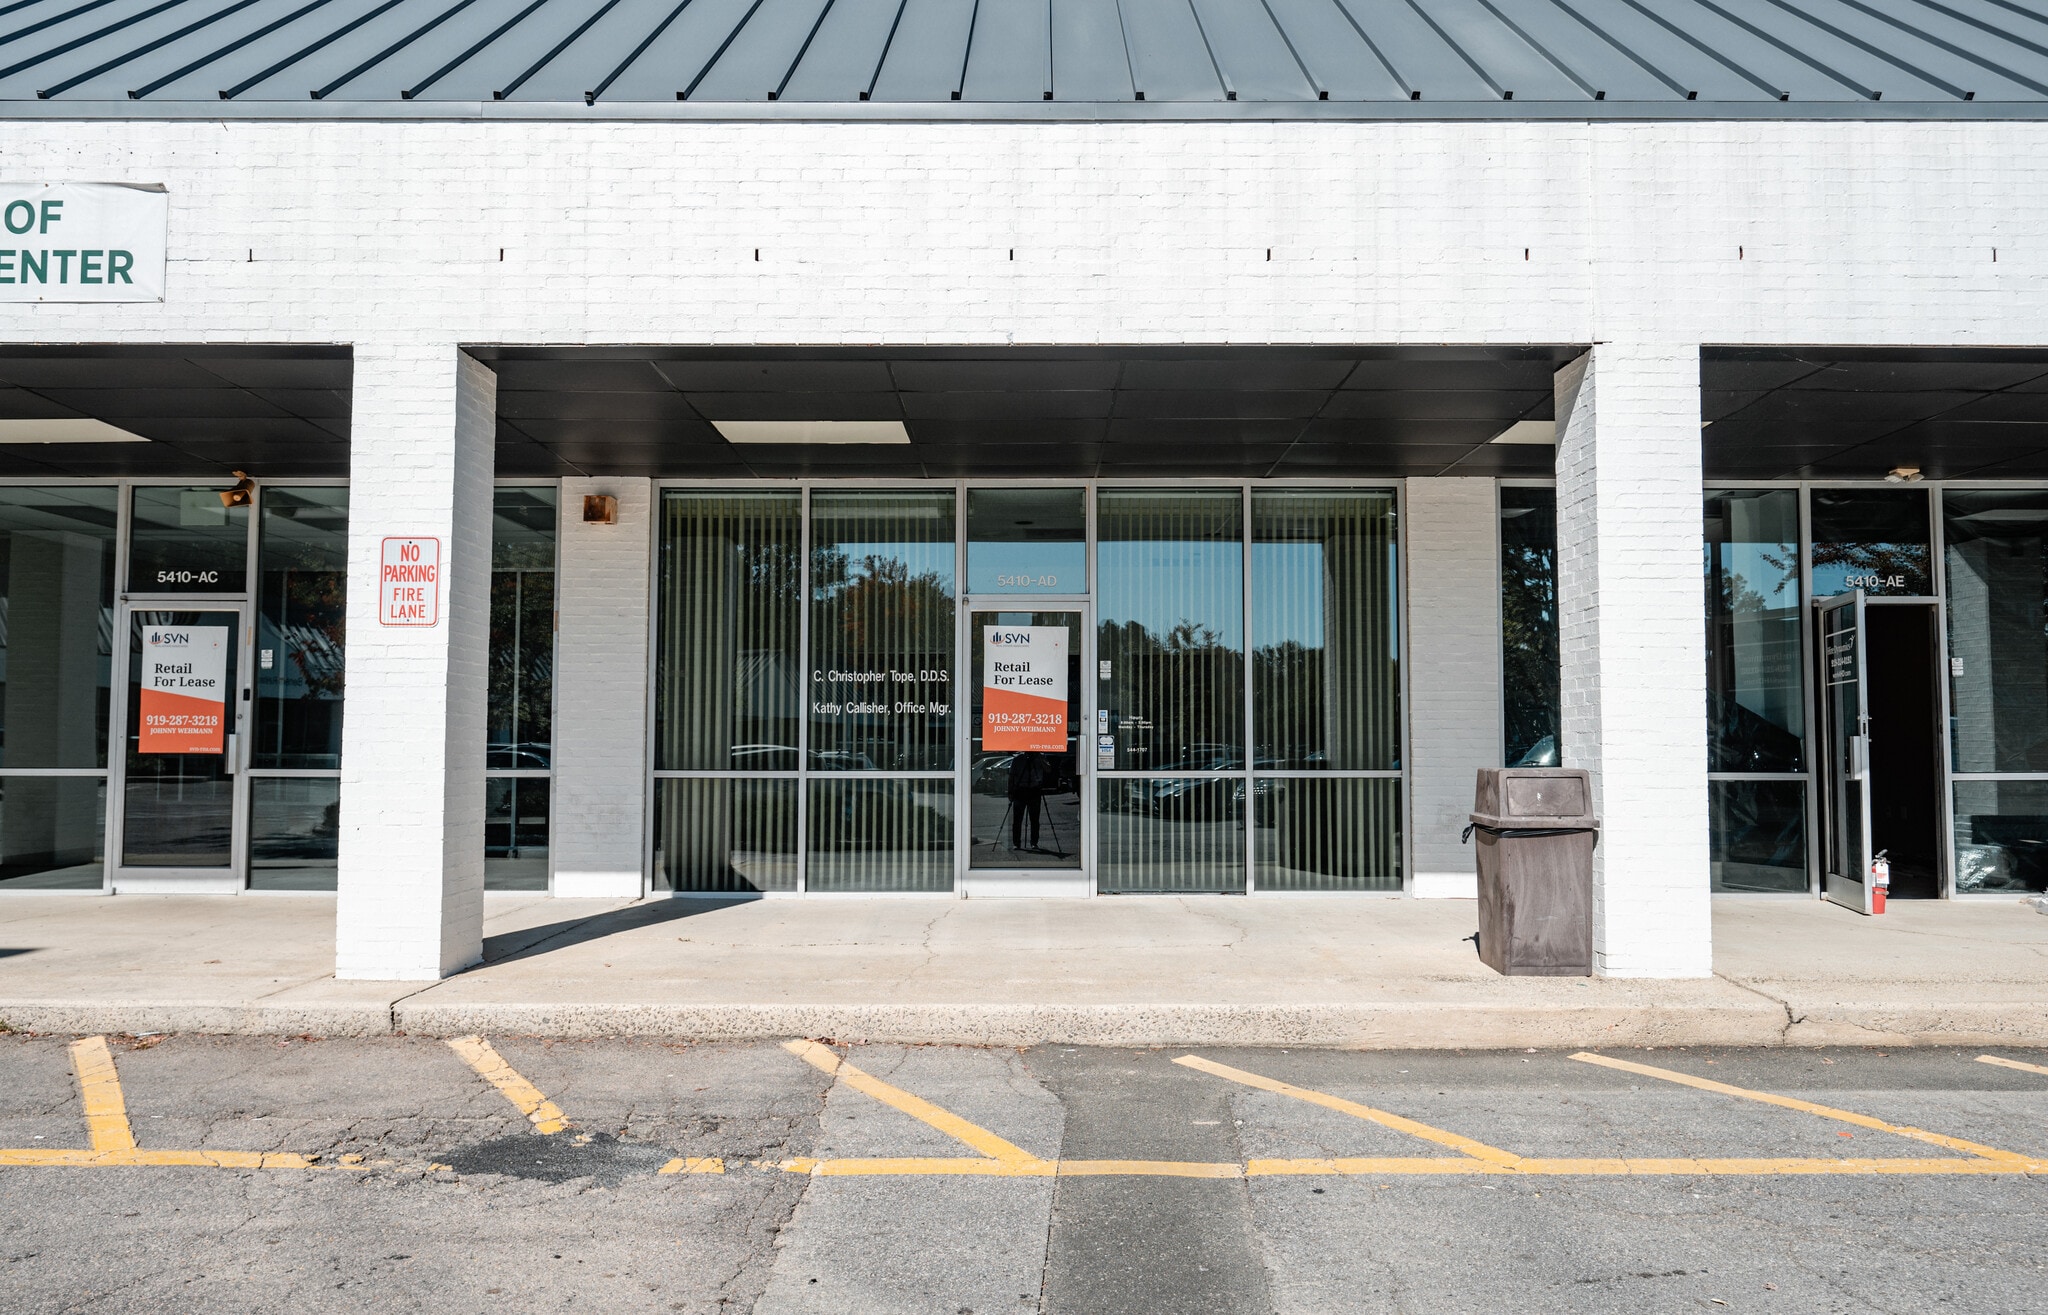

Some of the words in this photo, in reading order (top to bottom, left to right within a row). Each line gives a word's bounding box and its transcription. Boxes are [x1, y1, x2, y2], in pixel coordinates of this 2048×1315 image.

[4, 199, 64, 235] OF
[400, 544, 420, 562] NO
[157, 570, 219, 583] 5410-AC
[384, 564, 435, 583] PARKING
[997, 574, 1057, 588] 5410-AD
[1846, 575, 1905, 588] 5410-AE
[393, 587, 425, 602] FIRE
[390, 604, 426, 619] LANE
[164, 633, 189, 644] SVN
[1005, 632, 1030, 644] SVN
[154, 662, 192, 674] Retail
[994, 661, 1030, 672] Retail
[154, 676, 176, 687] For
[179, 676, 216, 687] Lease
[813, 669, 824, 682] C.
[828, 669, 886, 684] Christopher
[890, 669, 917, 684] Tope,
[920, 669, 950, 682] D.D.S.
[994, 674, 1015, 685] For
[1018, 675, 1053, 686] Lease
[812, 701, 842, 716] Kathy
[846, 701, 891, 716] Callisher,
[894, 701, 926, 714] Office
[929, 701, 952, 716] Mgr.
[146, 714, 218, 726] 919-287-3218
[988, 712, 1062, 725] 919-287-3218
[150, 727, 177, 736] JOHNNY
[993, 725, 1020, 734] JOHNNY
